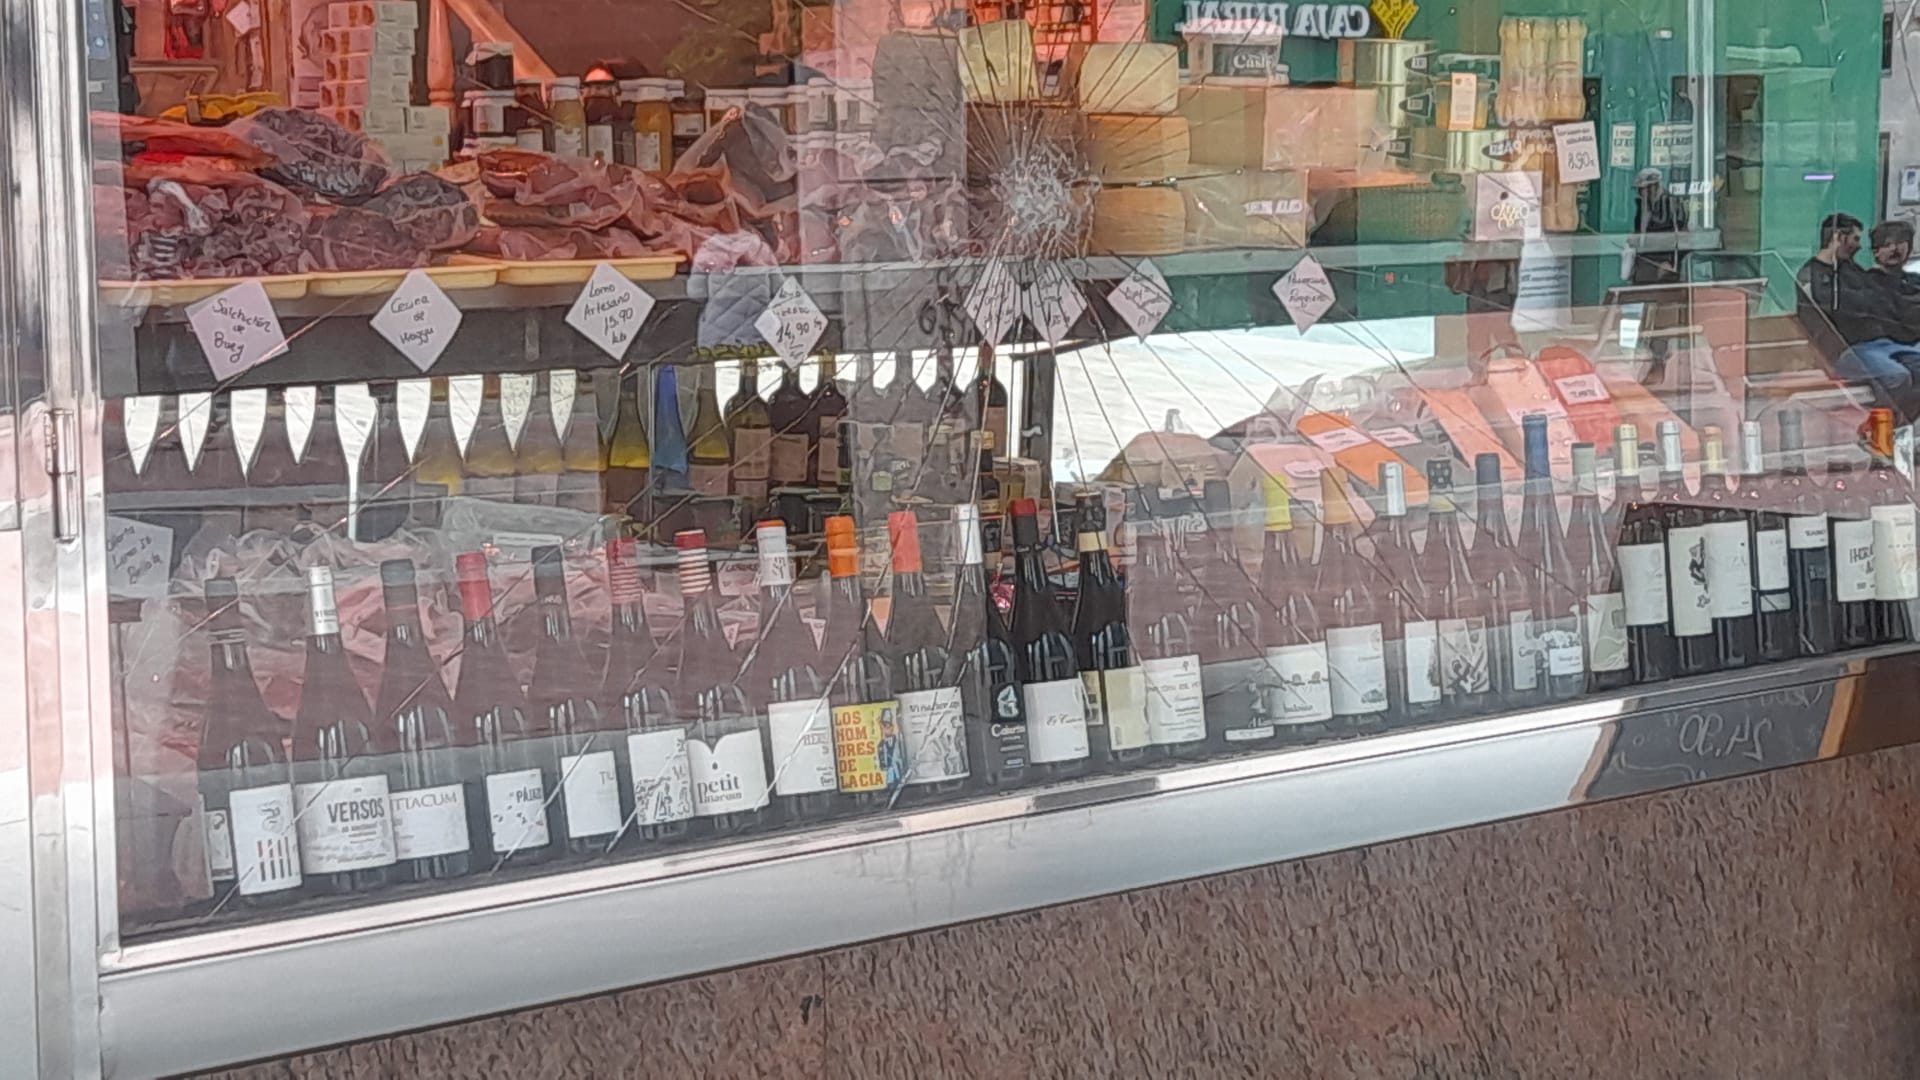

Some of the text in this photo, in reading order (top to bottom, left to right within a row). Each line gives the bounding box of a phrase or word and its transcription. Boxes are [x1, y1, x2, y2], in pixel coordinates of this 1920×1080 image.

[834, 710, 862, 726] LOS
[836, 727, 868, 743] HOM
[839, 759, 858, 773] DE
[697, 773, 741, 803] petit
[327, 797, 385, 823] VERSOS
